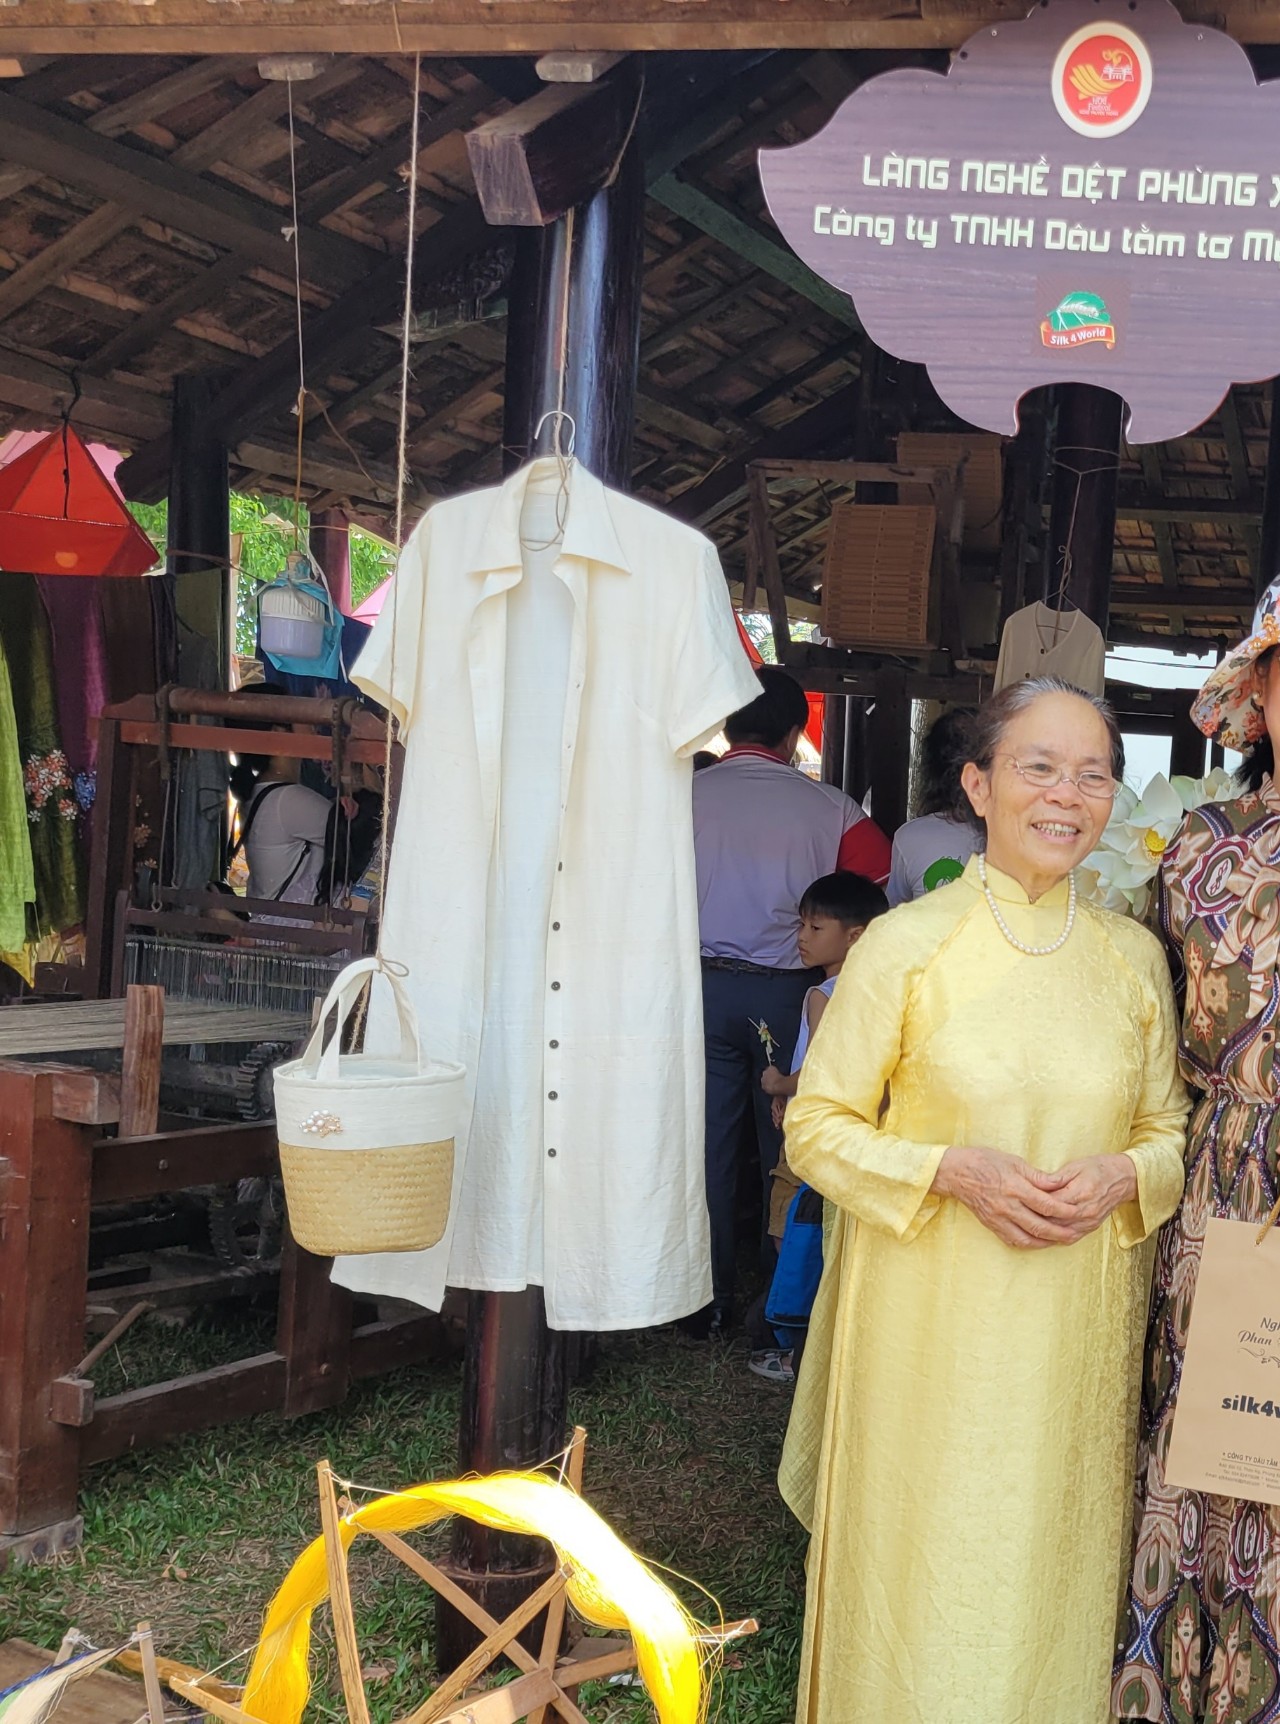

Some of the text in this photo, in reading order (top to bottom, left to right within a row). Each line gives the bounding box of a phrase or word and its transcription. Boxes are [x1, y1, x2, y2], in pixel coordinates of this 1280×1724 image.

[863, 151, 949, 190] LÀNG
[961, 154, 1049, 196] NGHỀ
[1061, 161, 1127, 204] DỆT
[1137, 165, 1258, 207] PHÙNG
[814, 204, 895, 246] Công
[906, 214, 938, 249] ty
[950, 213, 1034, 248] TNHH
[1045, 219, 1110, 252] Dâu
[1121, 223, 1185, 257] tằm
[1197, 232, 1233, 259] tơ
[1050, 328, 1106, 345] Silk 4 World
[1238, 1330, 1273, 1346] Phan
[1227, 1451, 1244, 1461] CÔNG
